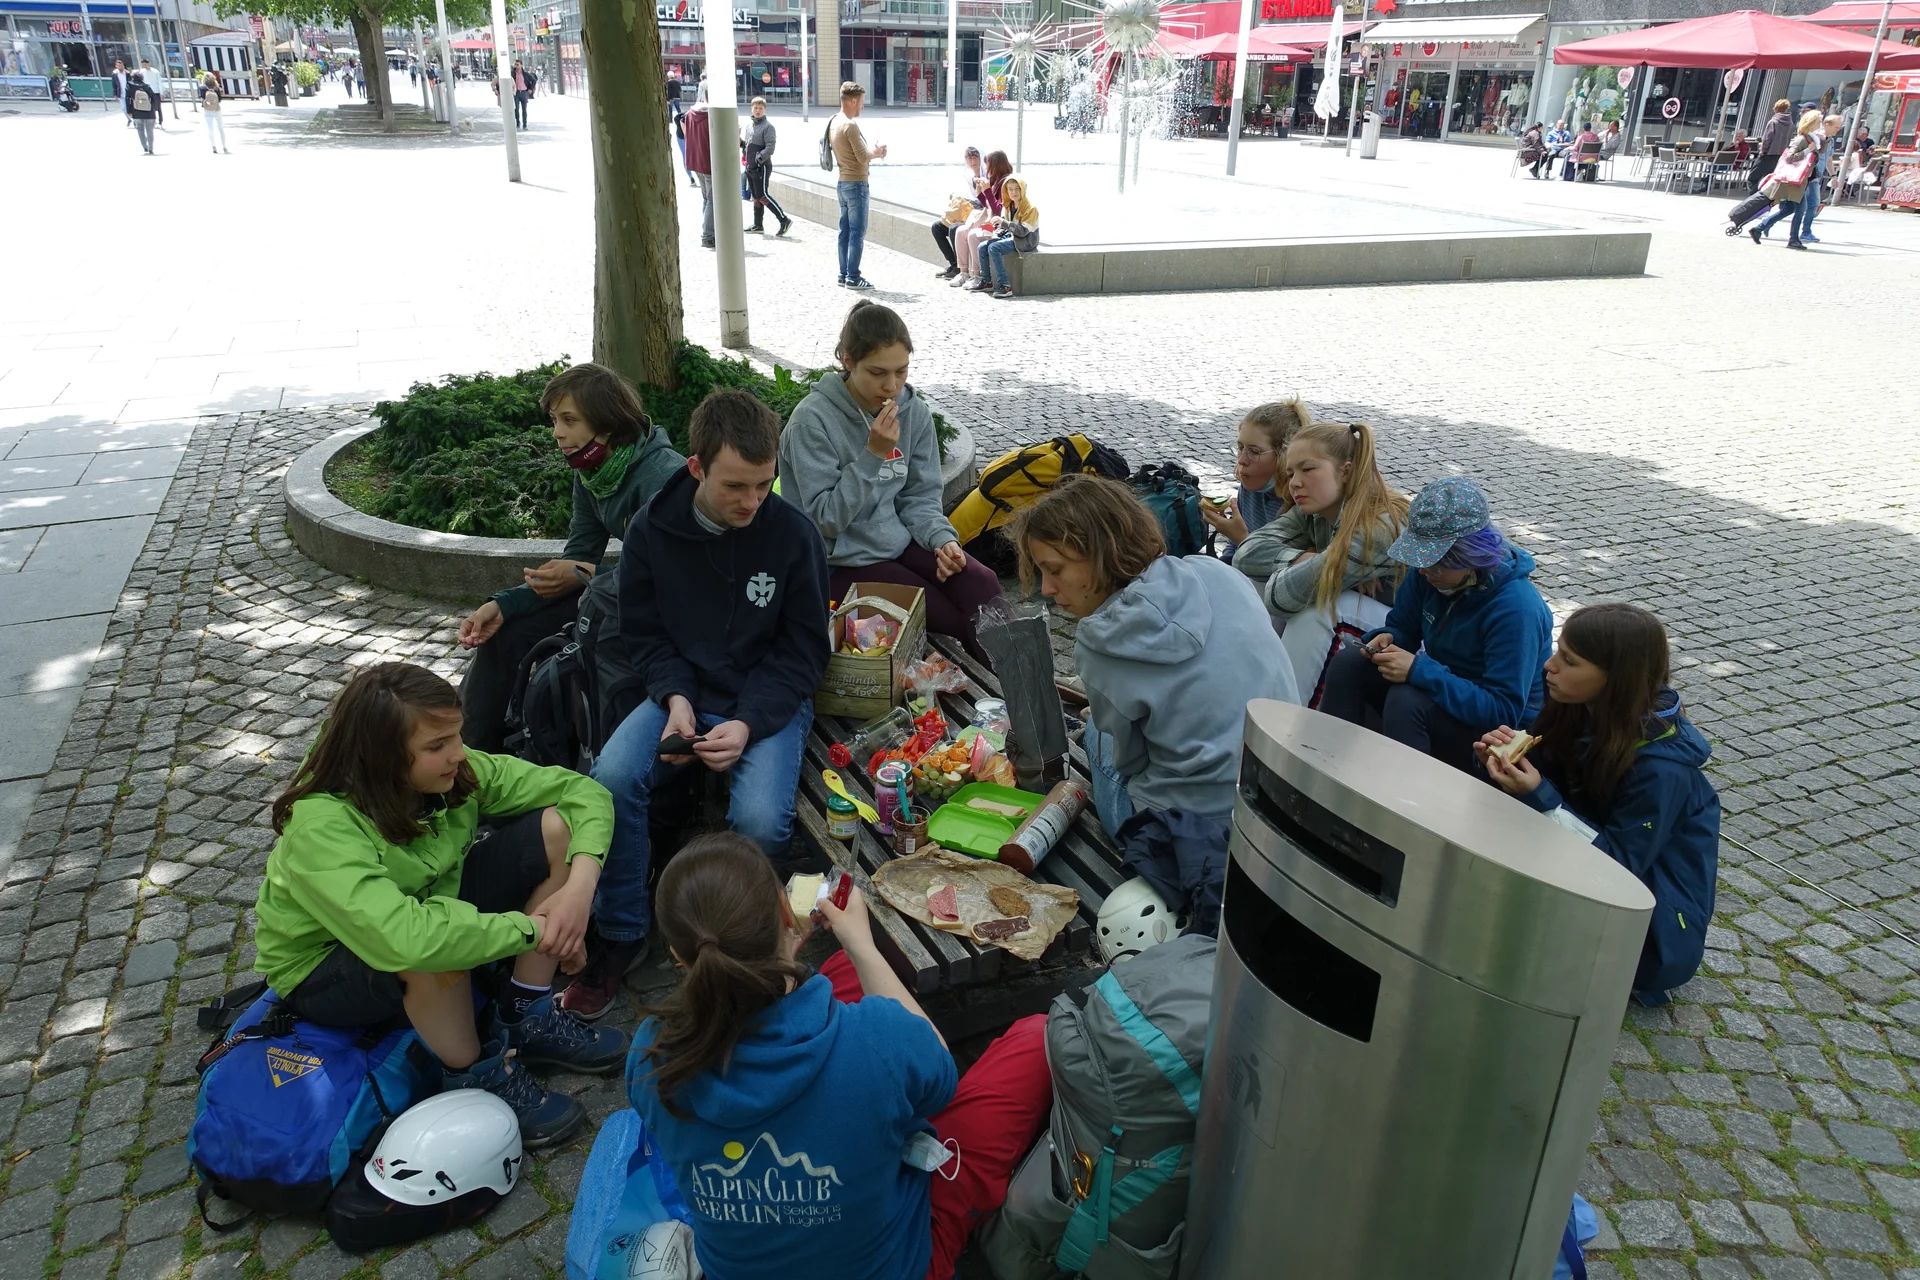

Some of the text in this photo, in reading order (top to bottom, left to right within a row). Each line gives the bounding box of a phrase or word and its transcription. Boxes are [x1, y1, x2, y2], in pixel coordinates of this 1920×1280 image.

[266, 1046, 324, 1066] FOR ADVENTURE
[695, 1197, 782, 1225] BERLIN
[783, 1203, 842, 1217] Sektions
[787, 1212, 842, 1228] Jugend
